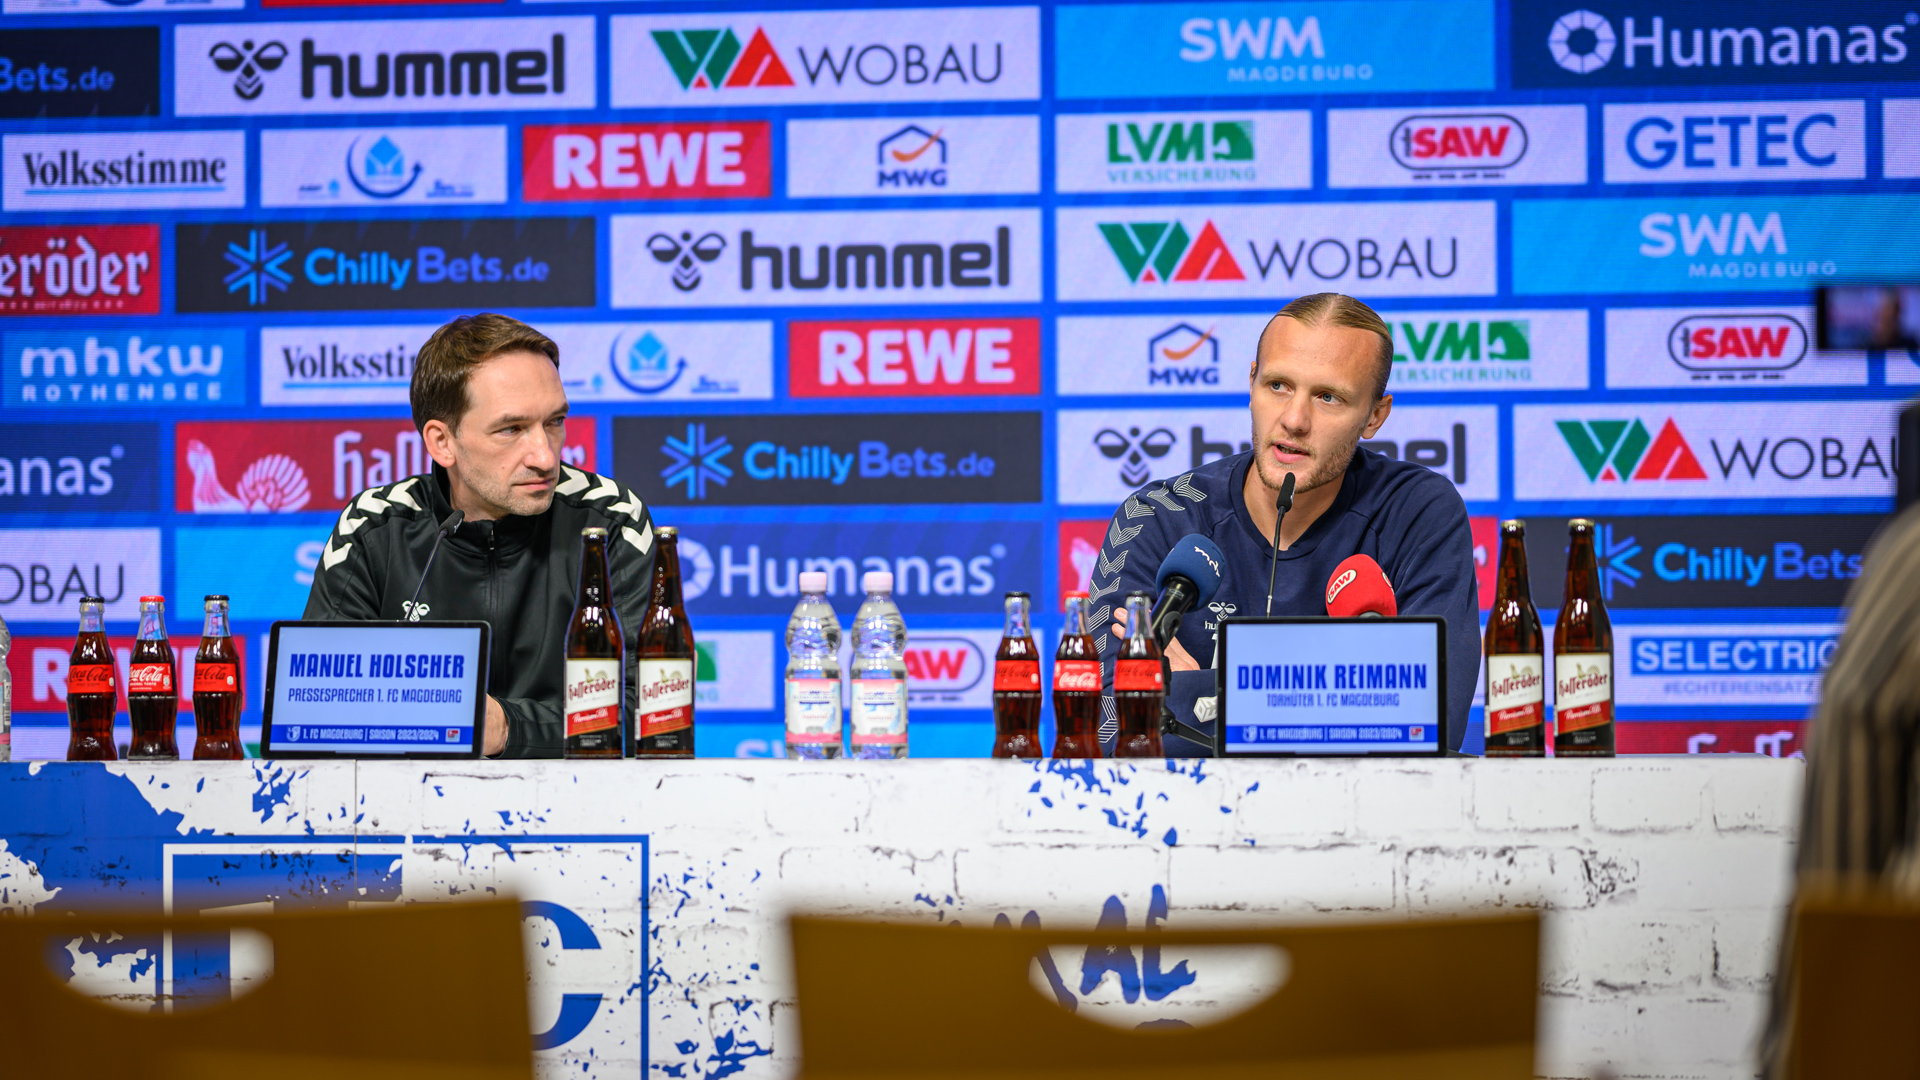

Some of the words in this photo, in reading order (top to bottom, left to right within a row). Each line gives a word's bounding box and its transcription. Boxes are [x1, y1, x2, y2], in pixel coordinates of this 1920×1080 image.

[1179, 16, 1325, 62] SWM
[301, 34, 564, 99] hummel
[798, 43, 1002, 85] WOBAU
[1227, 64, 1374, 82] MAGDEBURG
[1107, 122, 1205, 163] LVM
[1413, 126, 1510, 158] SAW
[1626, 114, 1837, 169] GETEC
[23, 151, 226, 187] Volksstimme
[553, 131, 746, 189] REWE
[1108, 167, 1256, 184] VERSICHERUNG
[878, 169, 947, 187] MWG
[1639, 212, 1787, 259] SWM
[740, 226, 1010, 290] hummel
[1250, 238, 1458, 279] WOBAU
[1688, 262, 1837, 279] MAGDEBURG
[20, 336, 223, 377] mhkw
[819, 328, 1015, 385] REWE
[1691, 326, 1790, 358] SAW
[283, 344, 416, 379] Volkssti
[1149, 367, 1220, 385] MWG
[1391, 367, 1531, 381] ERSICHERUNG
[22, 382, 222, 402] ROTHENSEE
[1709, 437, 1898, 480] WOBA
[1329, 571, 1351, 598] SAW
[289, 653, 363, 678] MANUEL
[903, 649, 968, 680] AW
[1237, 665, 1327, 690] DOMINIK
[1334, 664, 1427, 689] REIMANN
[288, 687, 374, 703] PRESSESPRECHER
[377, 688, 384, 702] 1.
[387, 688, 398, 703] FC
[401, 689, 462, 703] MAGDEBURG
[1267, 690, 1314, 707] TORHÜTER
[1317, 693, 1324, 707] 1.
[1327, 693, 1338, 707] FC
[1340, 693, 1400, 707] MAGDEBURG
[319, 729, 363, 740] MAGDEBURG
[369, 729, 396, 741] SAISON
[1277, 727, 1323, 740] MAGDEBURG
